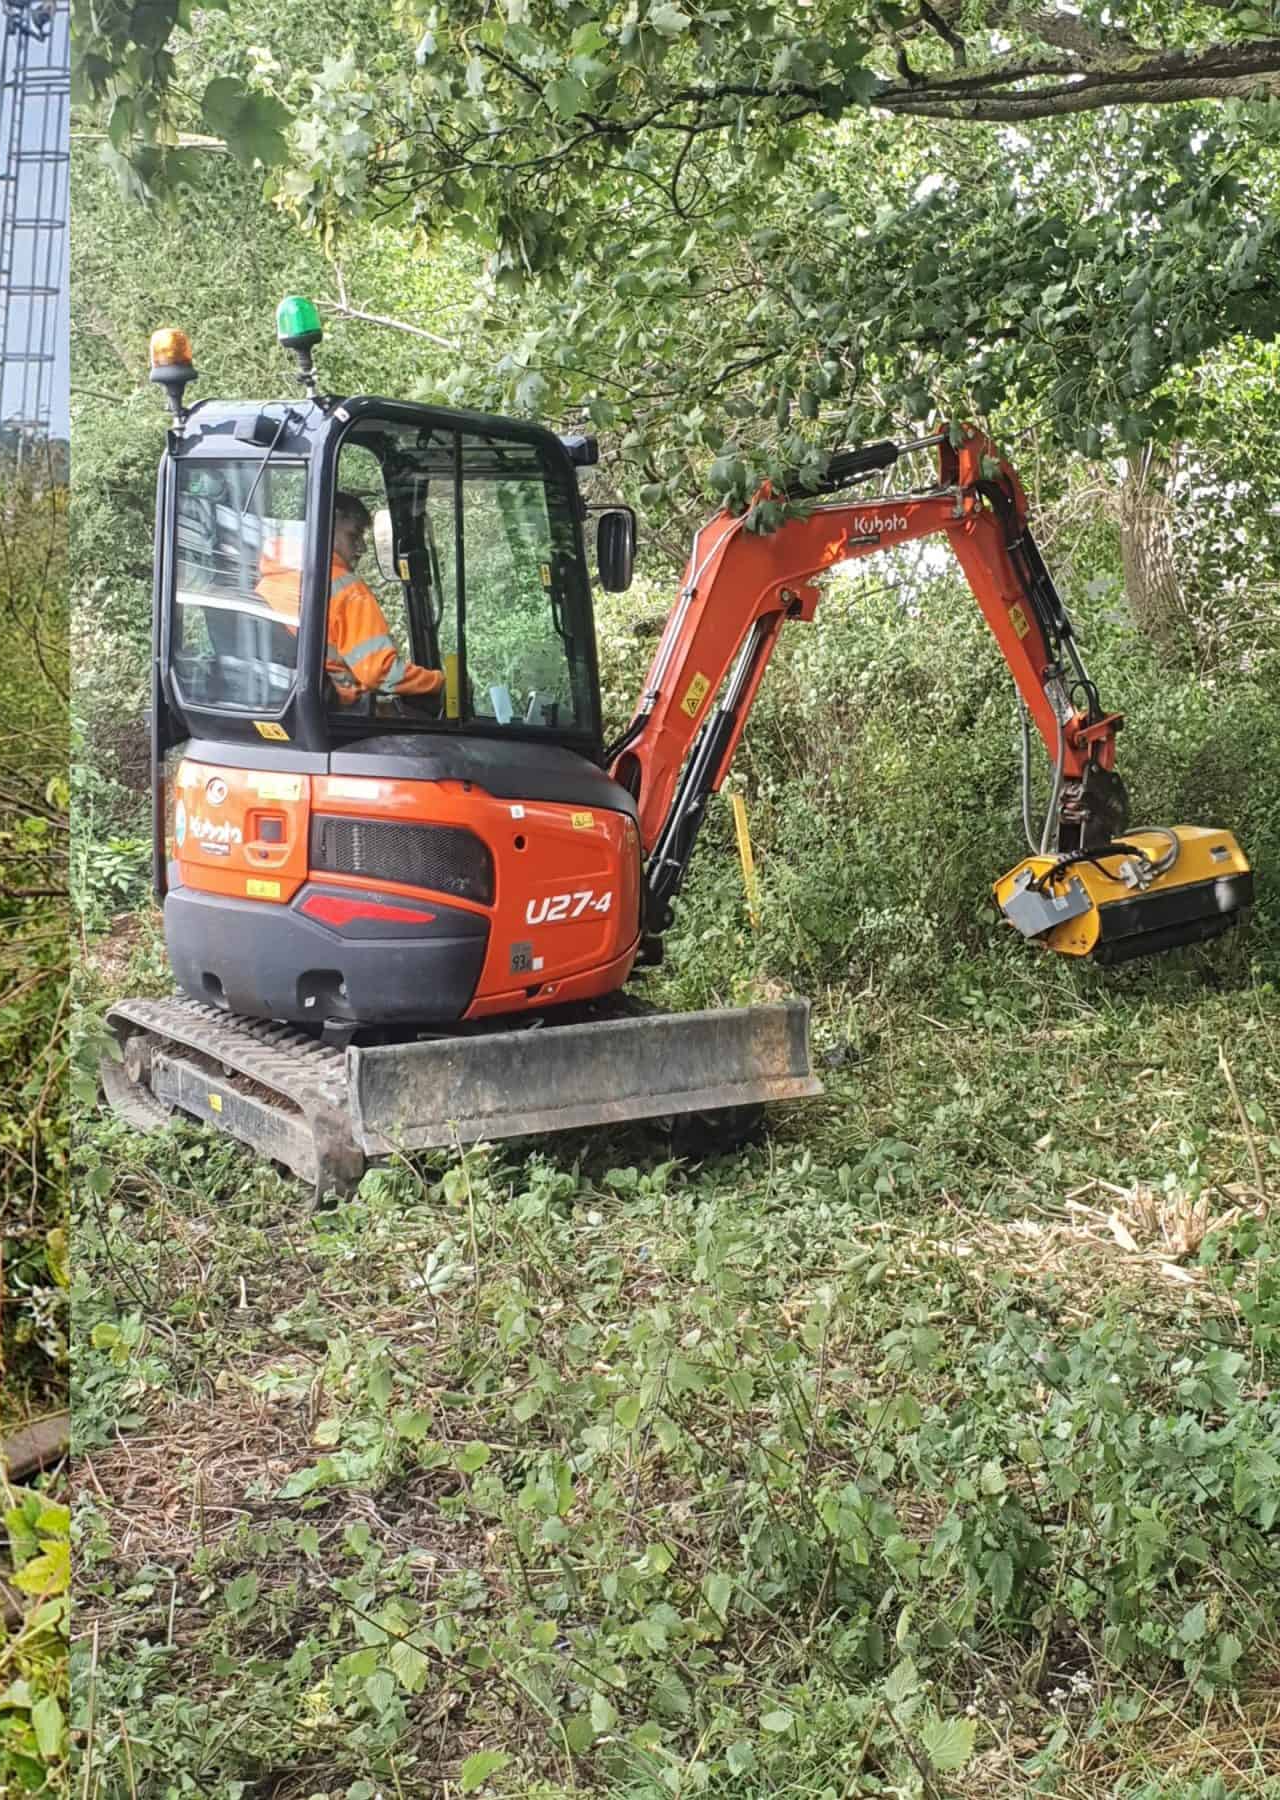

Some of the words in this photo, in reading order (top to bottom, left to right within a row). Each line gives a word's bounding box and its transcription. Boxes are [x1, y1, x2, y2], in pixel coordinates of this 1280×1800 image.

[854, 512, 908, 535] Kubota
[189, 815, 243, 844] Kubota
[525, 890, 613, 925] U27-4
